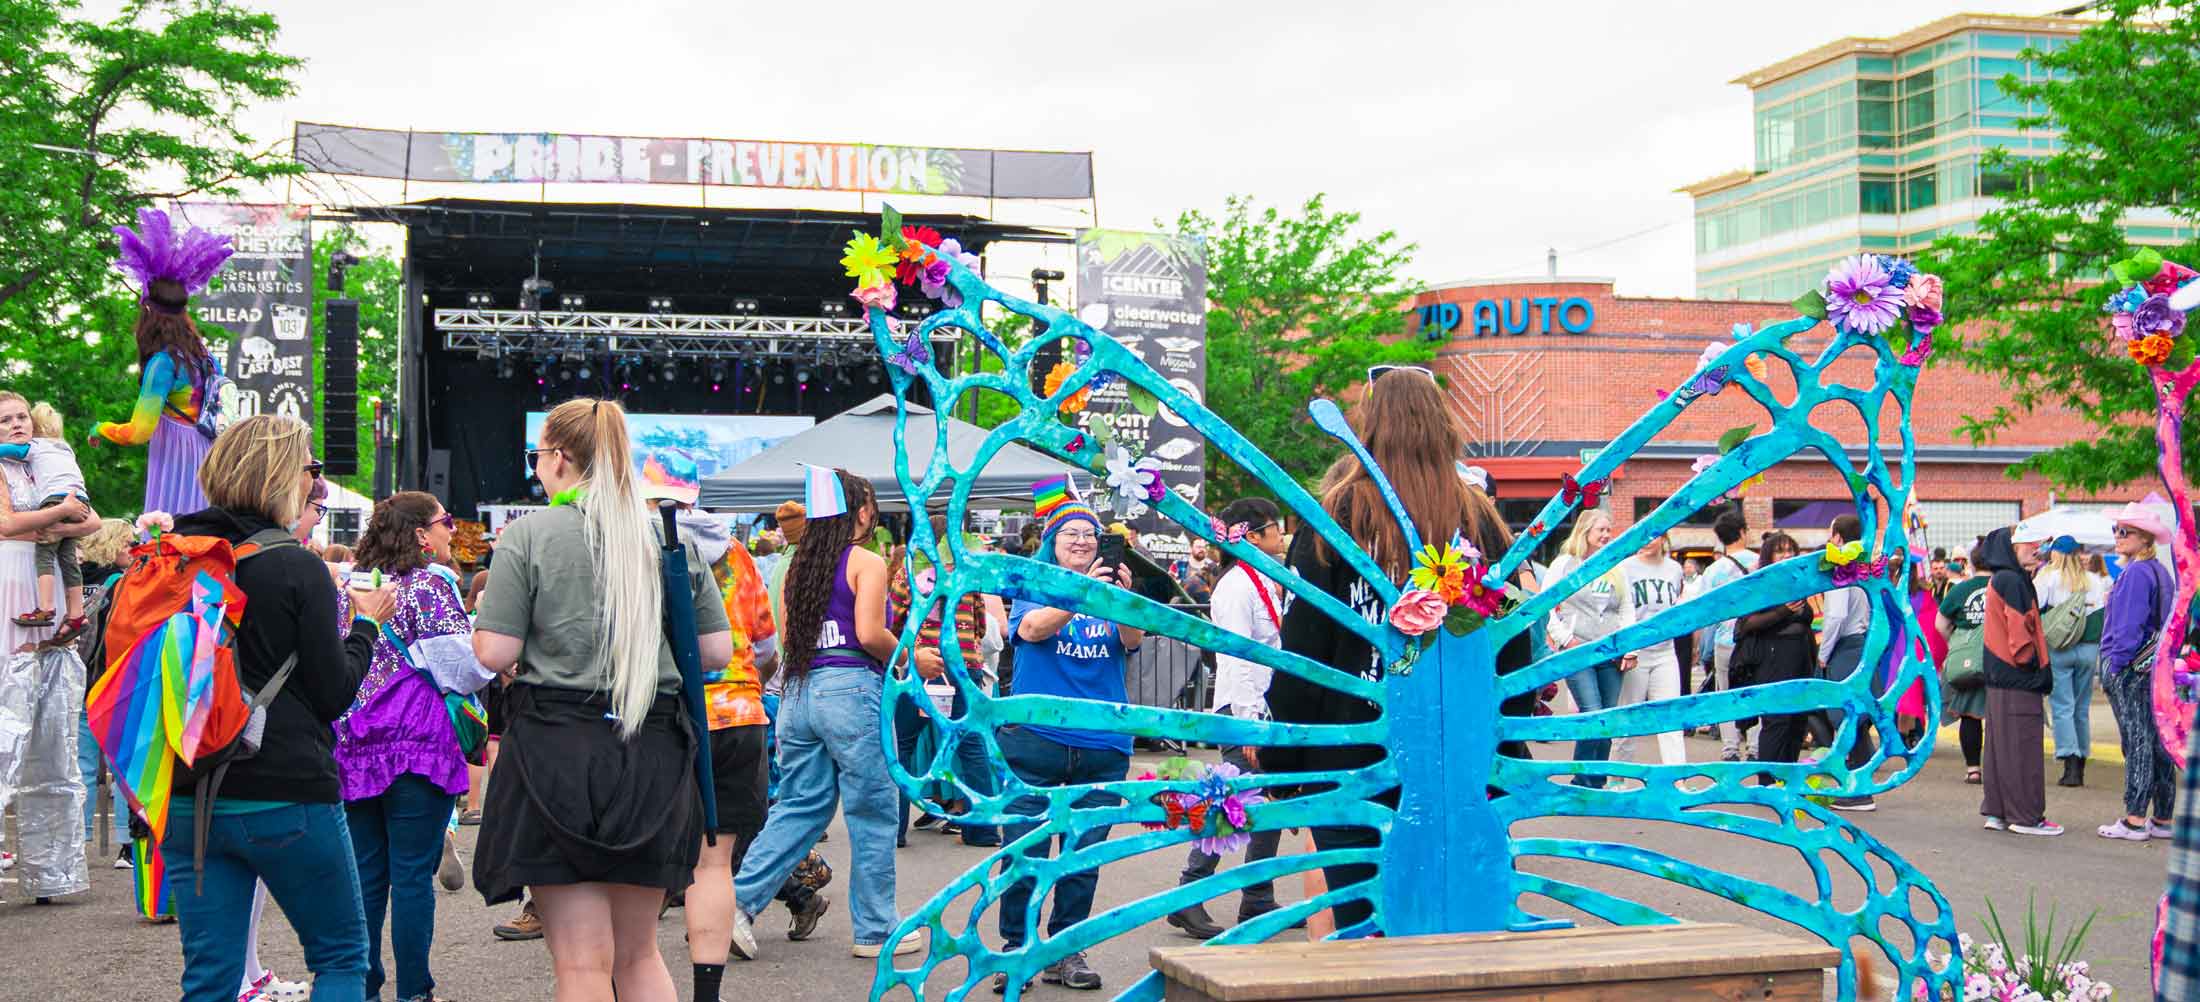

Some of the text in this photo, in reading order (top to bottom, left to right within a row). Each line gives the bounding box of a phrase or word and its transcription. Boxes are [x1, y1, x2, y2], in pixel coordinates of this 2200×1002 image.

[473, 135, 650, 183] PRIDE
[687, 139, 929, 193] PREVENTION
[239, 238, 303, 252] HEYKA
[222, 281, 304, 294] IAGNOSTICS
[1110, 276, 1183, 296] CENTER
[197, 307, 263, 322] GILEAD
[1114, 304, 1203, 326] clearwater
[1473, 297, 1596, 335] AUTO
[1078, 411, 1151, 428] ZO CITY
[1056, 640, 1110, 659] MAMA
